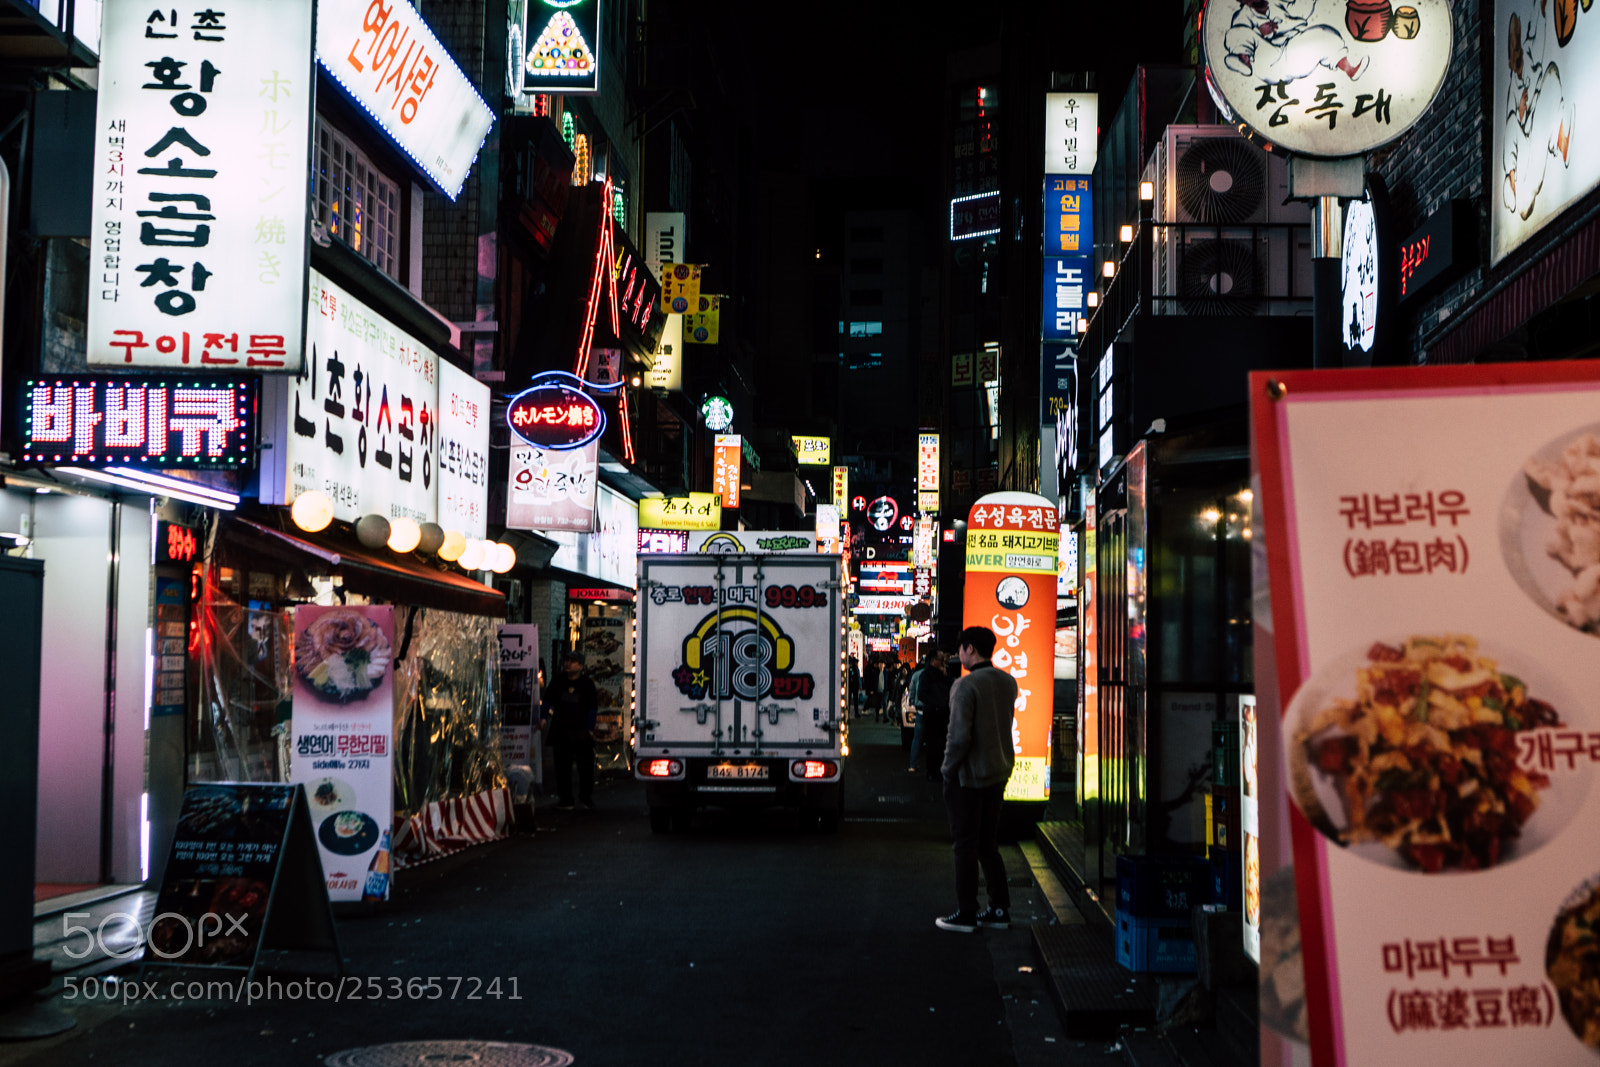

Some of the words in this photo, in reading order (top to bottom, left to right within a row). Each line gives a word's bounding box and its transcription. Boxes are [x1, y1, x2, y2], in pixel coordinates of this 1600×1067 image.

[145, 9, 226, 41] 신촌
[348, 0, 440, 125] 연어사랑
[1255, 80, 1392, 130] 장독대
[135, 56, 221, 316] 황소곱창
[255, 70, 293, 285] ホルモン焼き
[1055, 260, 1083, 369] 노블레스
[109, 330, 287, 367] 구이전문
[31, 386, 239, 457] 바비큐
[513, 405, 594, 427] ホルモン焼き
[440, 436, 487, 488] 신촌황소곱창
[661, 519, 683, 528] Japanese
[684, 520, 700, 528] Dining
[973, 506, 1057, 530] 숙성육전문
[1339, 490, 1470, 529] 궈보러우
[1343, 534, 1470, 578] (鍋包肉)
[576, 589, 610, 598] JOKBAL
[651, 585, 682, 605] 종로
[764, 584, 828, 609] 99.9%
[296, 734, 336, 757] 생연어
[337, 734, 388, 757] 무한리필
[348, 759, 370, 770] 2가지
[737, 767, 763, 777] 8174
[1382, 936, 1520, 979] 마파두부
[1387, 982, 1555, 1035] (麻婆豆腐)
